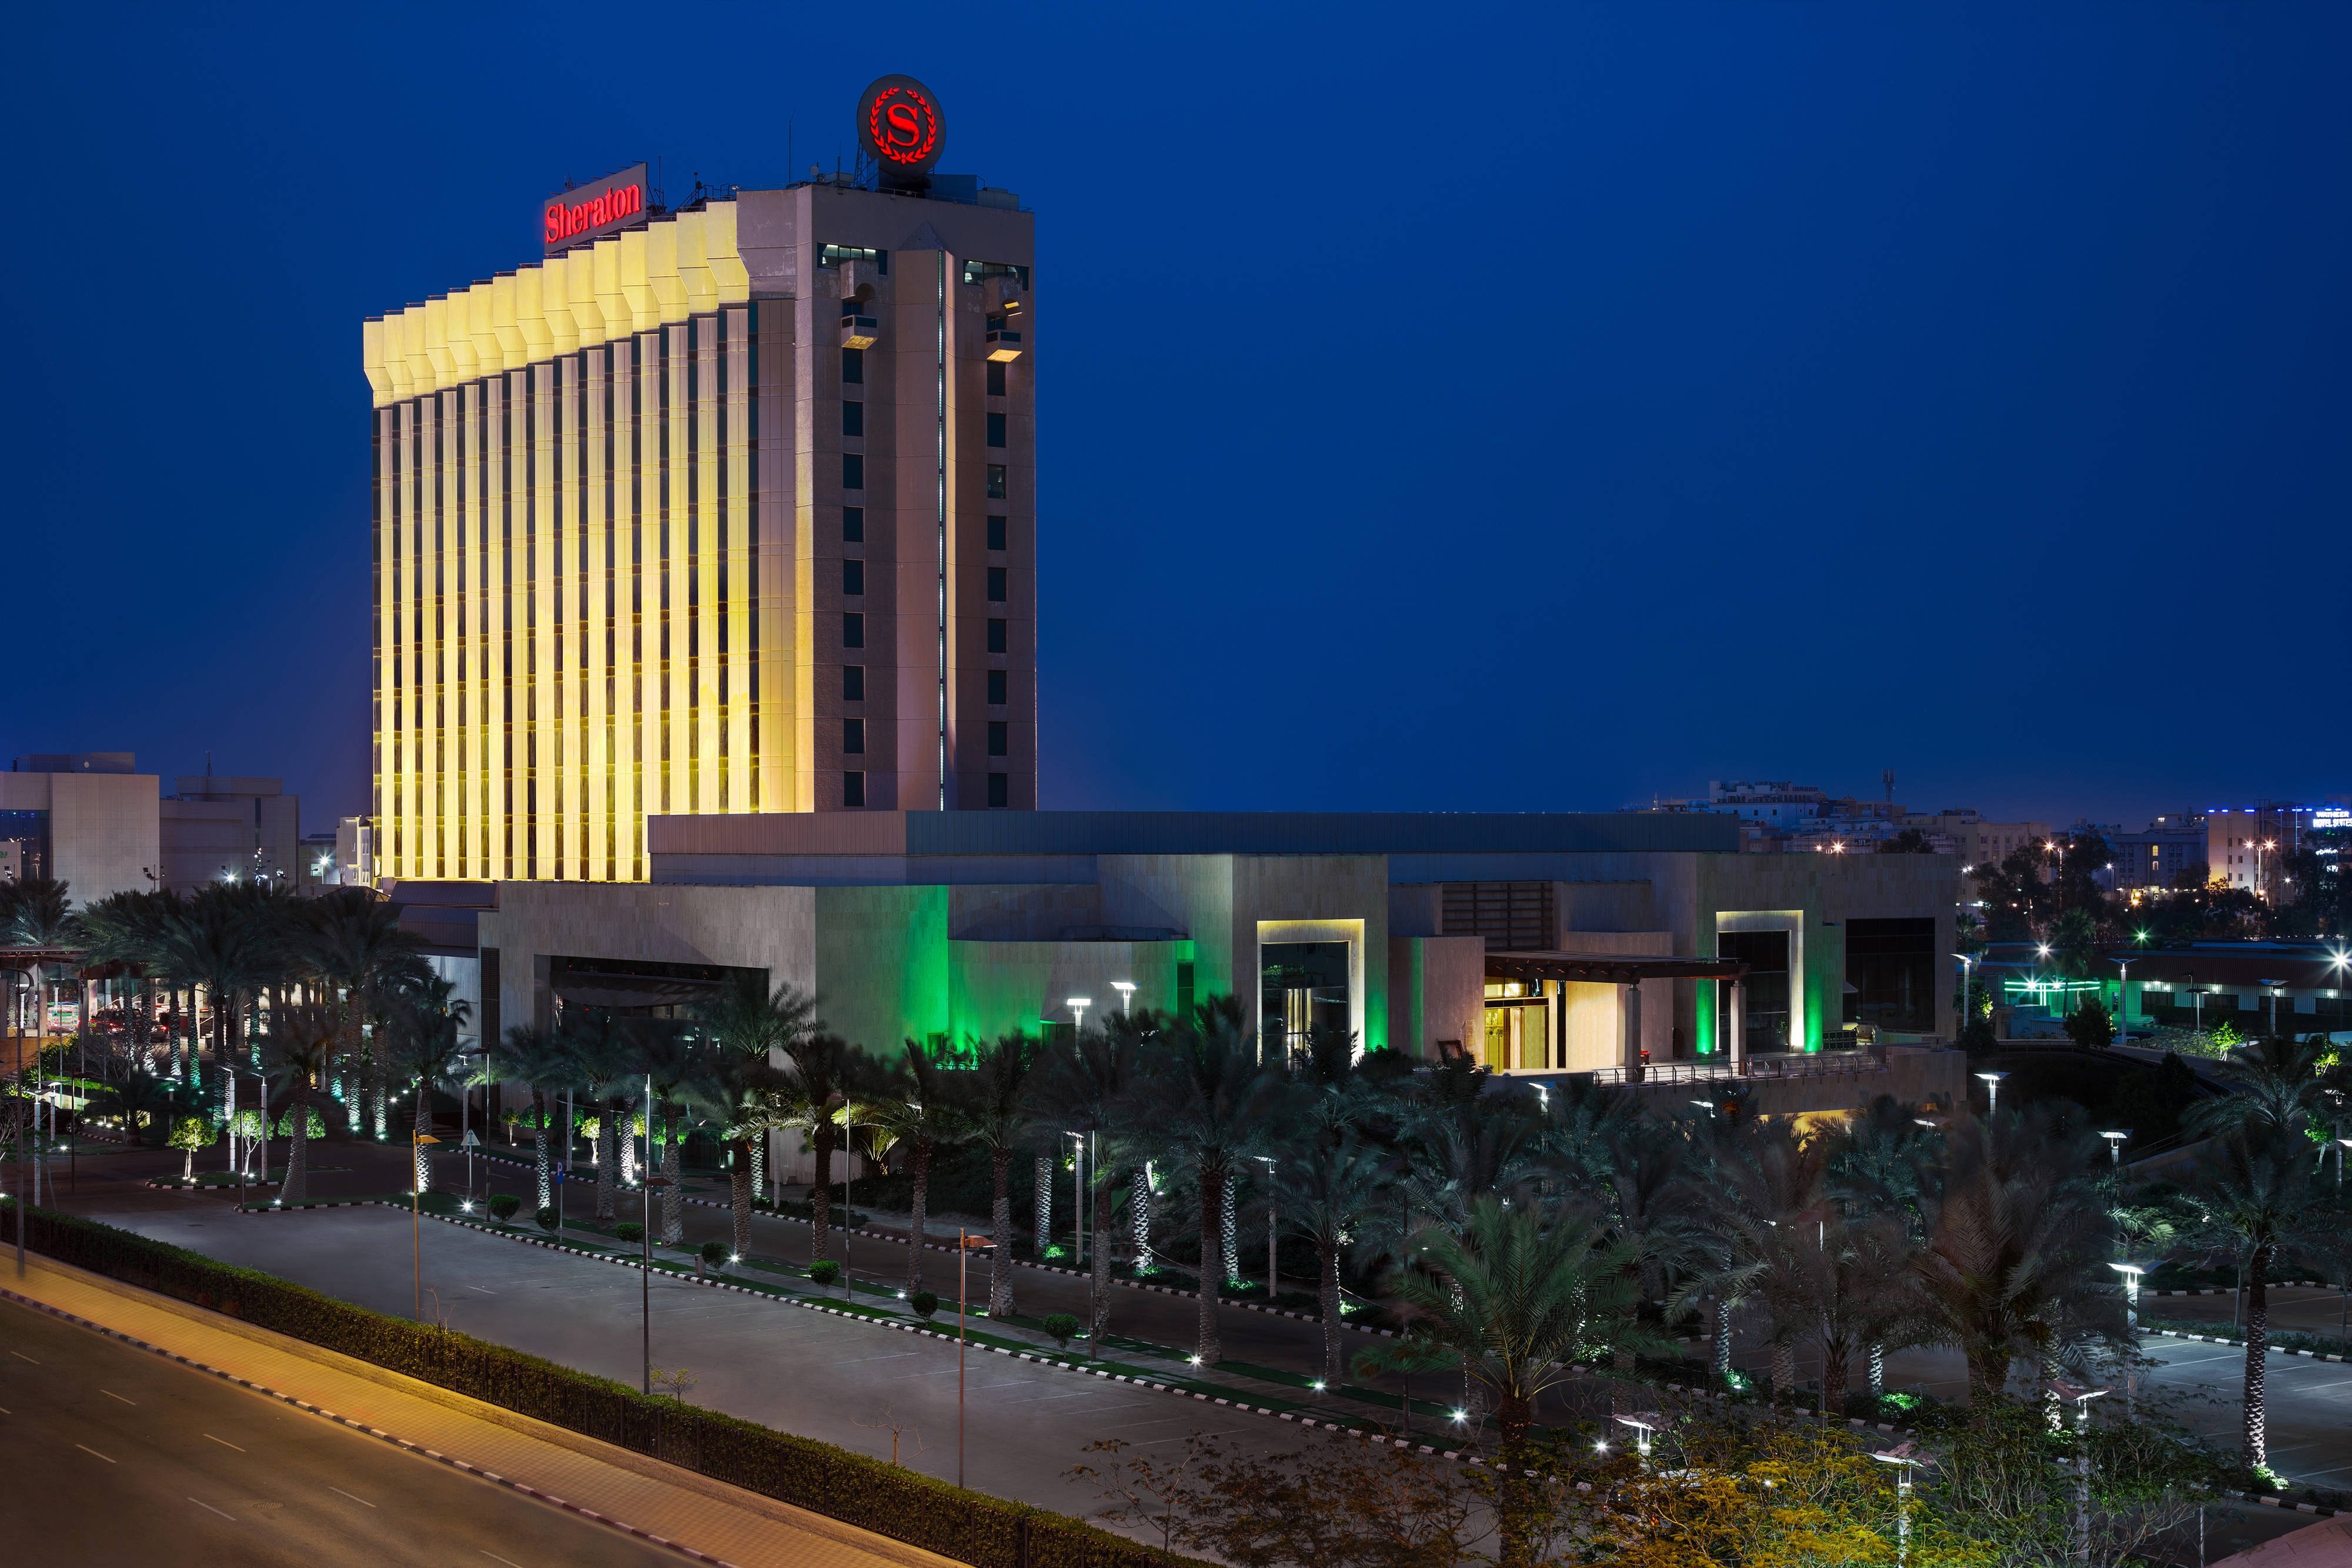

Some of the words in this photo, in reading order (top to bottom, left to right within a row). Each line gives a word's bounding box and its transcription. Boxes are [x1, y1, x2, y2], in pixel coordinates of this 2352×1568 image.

[887, 103, 920, 146] S
[546, 183, 640, 243] Sheraton
[2313, 818, 2333, 828] HOTEL
[557, 1161, 563, 1176] P
